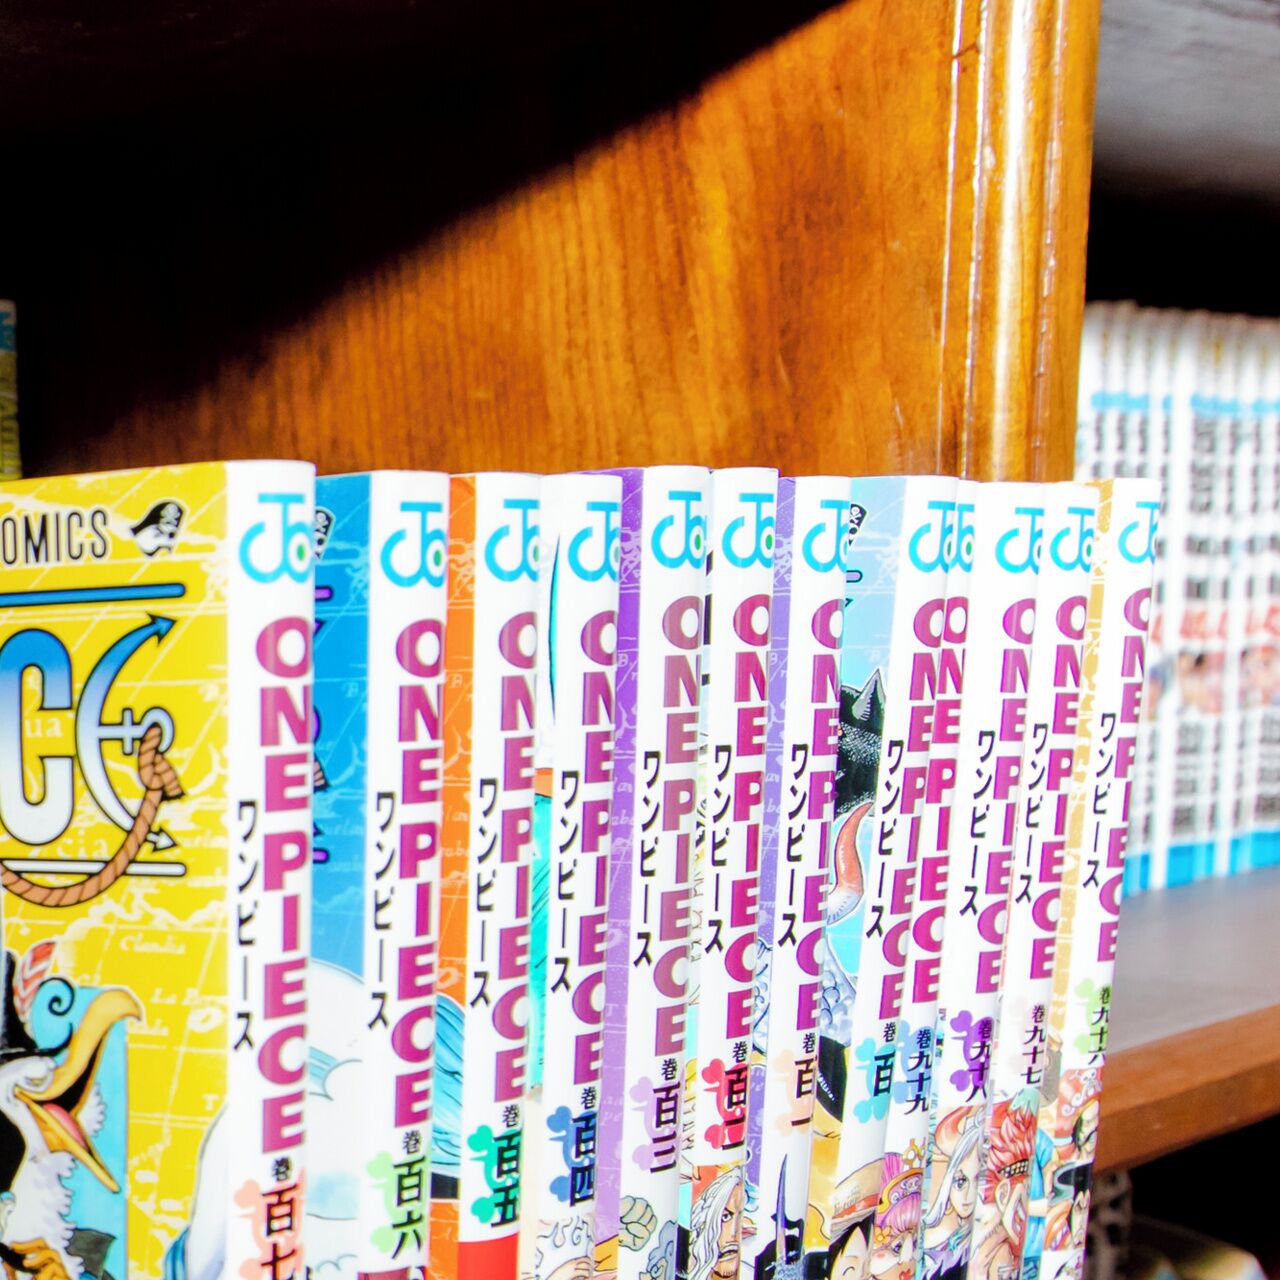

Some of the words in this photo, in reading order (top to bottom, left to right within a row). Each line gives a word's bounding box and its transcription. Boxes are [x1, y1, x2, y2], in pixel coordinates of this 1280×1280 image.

[256, 615, 311, 814] ONE
[396, 619, 445, 804] ONE
[499, 611, 538, 792] ONE
[581, 610, 617, 784] ONE
[662, 595, 702, 765] ONE
[734, 594, 772, 757] ONE
[368, 791, 395, 1031] ワンピース
[469, 778, 498, 1008] ワンピース
[551, 770, 580, 994] ワンピース
[653, 778, 692, 1057] PIECE
[705, 744, 732, 954] ワンピース
[724, 771, 764, 1039] PIECE
[866, 740, 903, 938] ワンピース
[960, 731, 996, 916] ワンピース
[1015, 723, 1048, 903] ワンピース
[233, 800, 261, 1052] ワンピース
[257, 831, 311, 1154] PIECE
[391, 822, 440, 1129] PIECE
[492, 805, 535, 1102] PIECE
[571, 797, 610, 1086] PIECE
